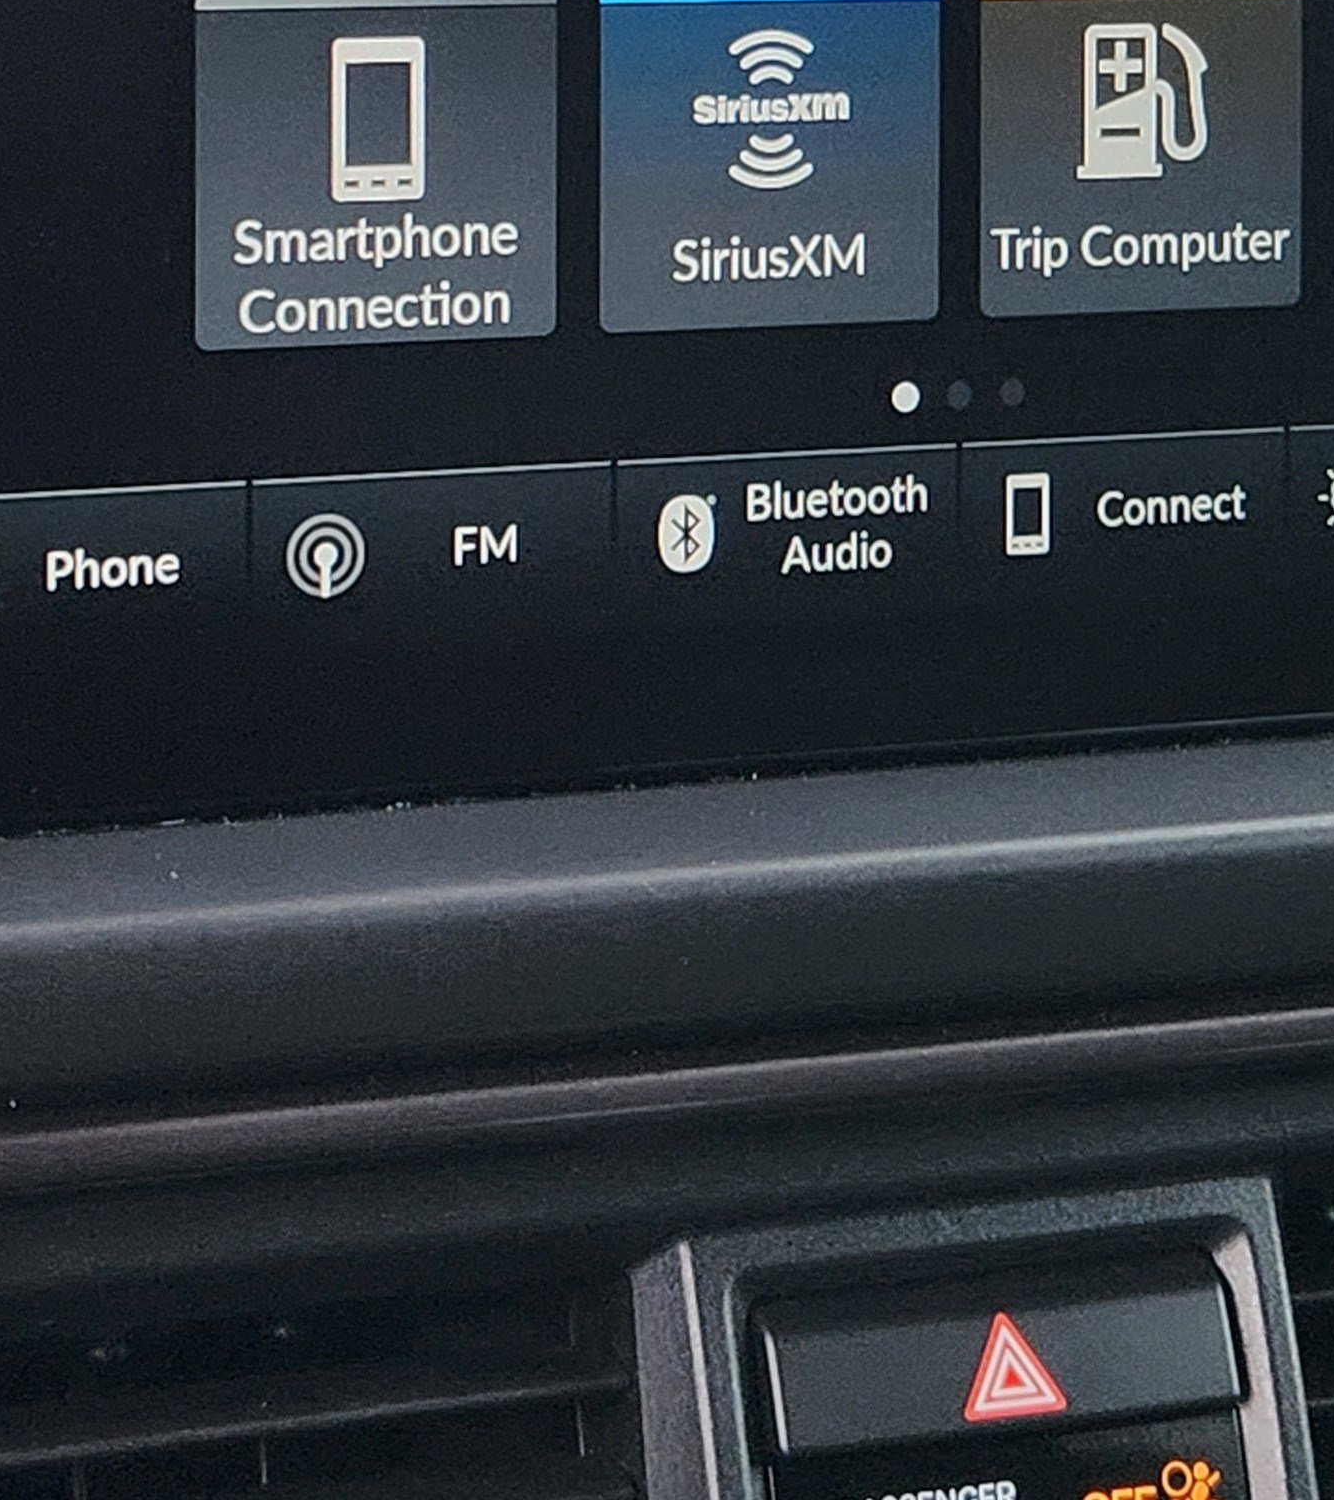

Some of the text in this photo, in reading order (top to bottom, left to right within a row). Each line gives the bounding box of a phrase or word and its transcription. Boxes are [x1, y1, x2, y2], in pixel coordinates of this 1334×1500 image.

[233, 211, 519, 269] Smartphone
[671, 232, 866, 283] SiriusXM
[988, 220, 1292, 278] Trip Computer
[238, 279, 511, 334] Connection
[746, 473, 929, 523] Bluetooth
[1096, 483, 1247, 529] Connect
[45, 546, 181, 593] Phone
[453, 522, 519, 567] FM
[779, 529, 894, 575] Audio
